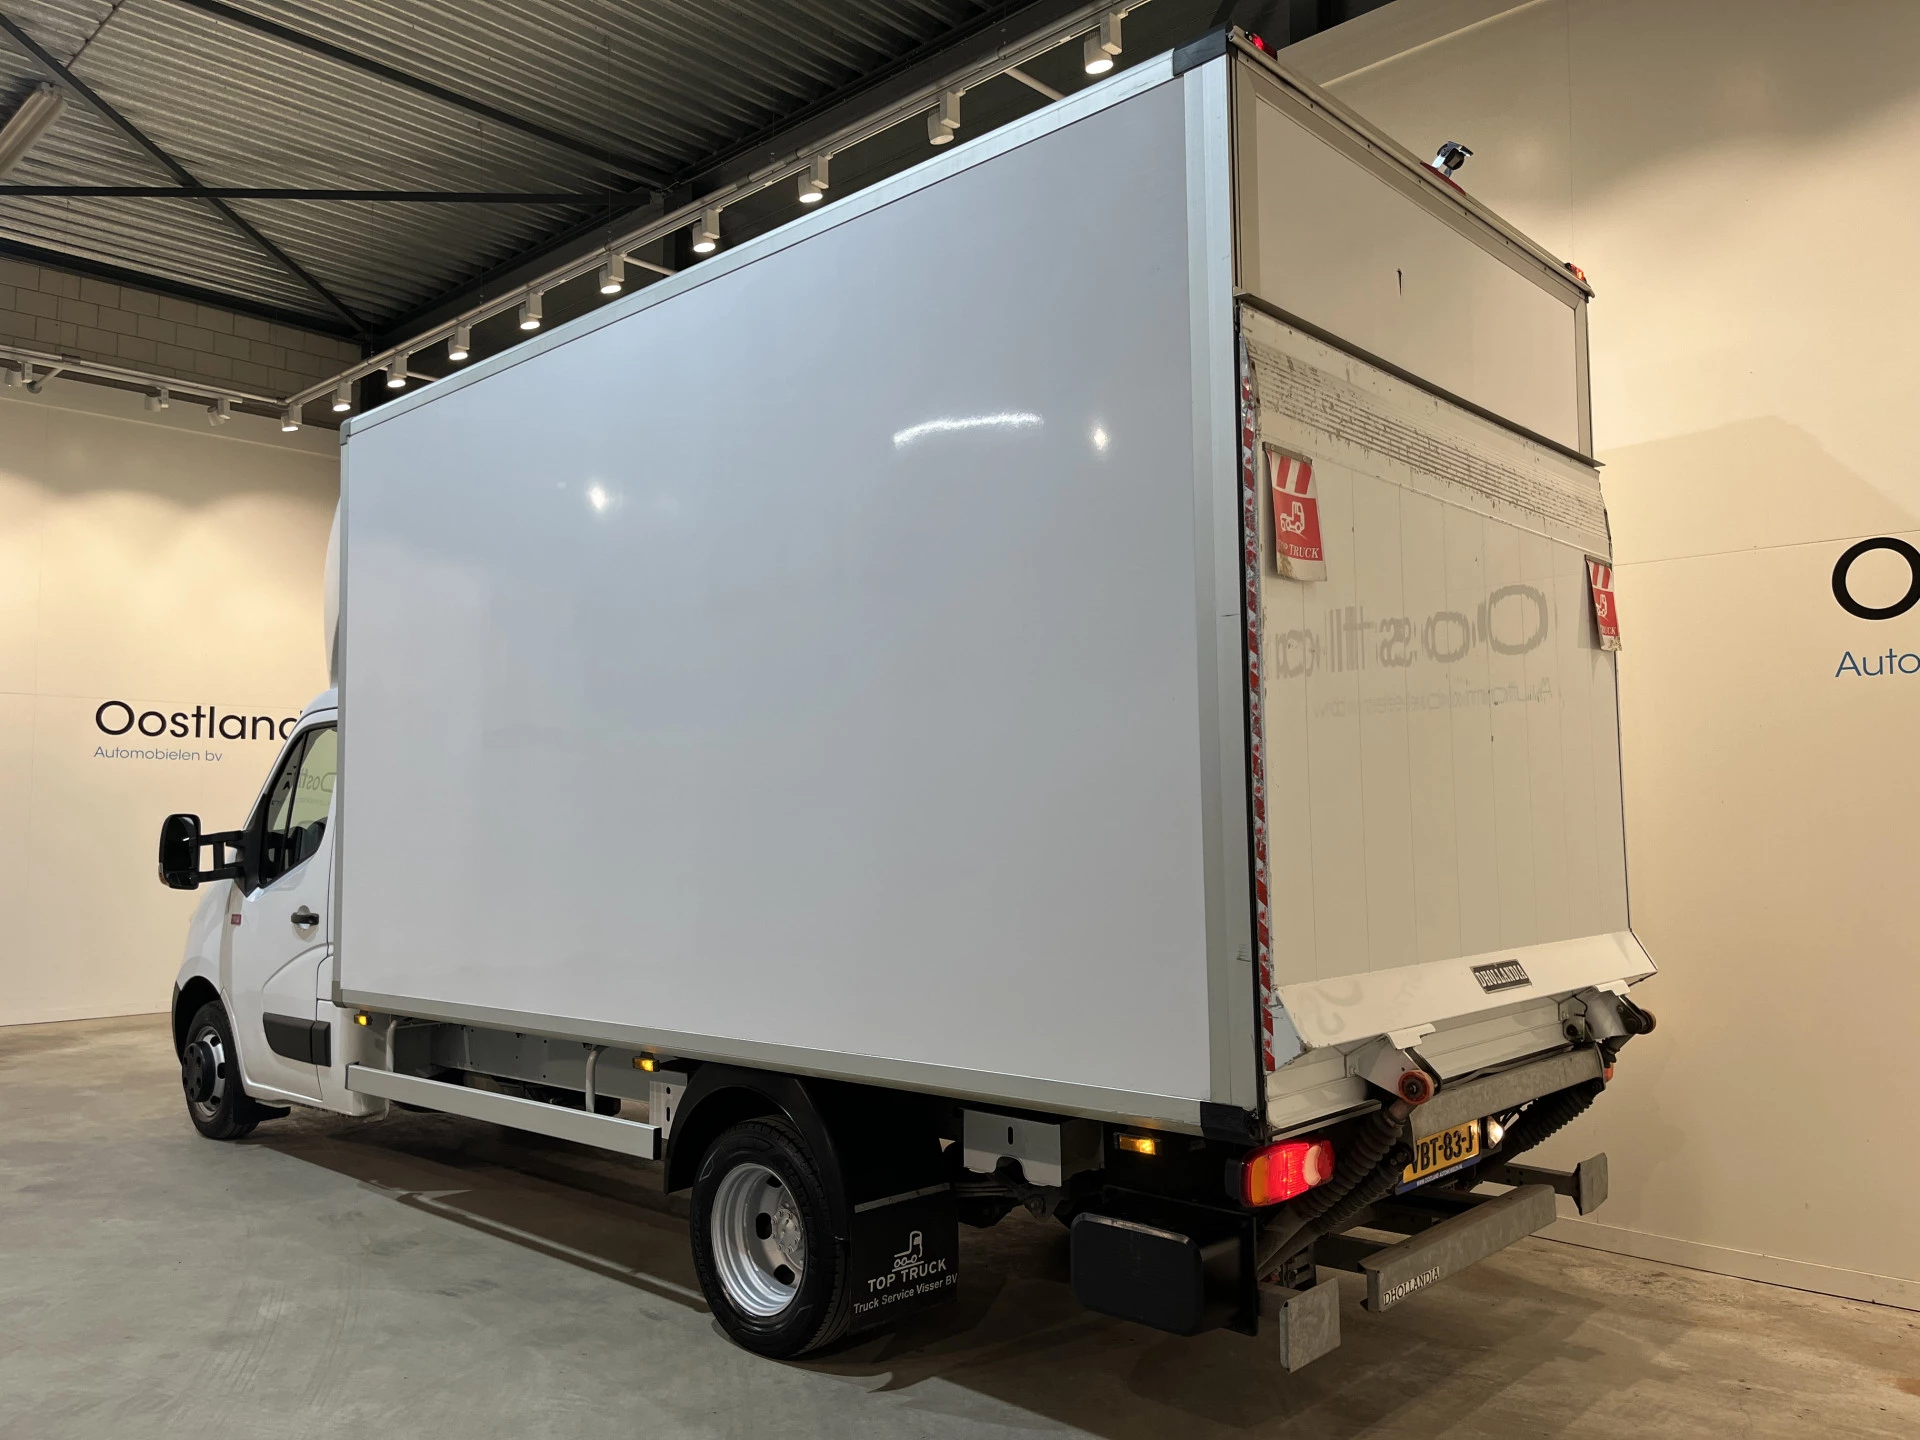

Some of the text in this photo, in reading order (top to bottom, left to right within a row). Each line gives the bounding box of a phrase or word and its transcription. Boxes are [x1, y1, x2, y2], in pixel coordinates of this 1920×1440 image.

[1290, 543, 1320, 559] TRUCK
[1835, 648, 1920, 678] Auto
[93, 746, 223, 762] Automobielen bv
[1475, 964, 1529, 987] DHOLLANDIA
[867, 1258, 947, 1293] TOP TRUCK
[1384, 1266, 1440, 1306] DHOLLANDIA
[853, 1273, 958, 1314] Truck Service Visser BV
